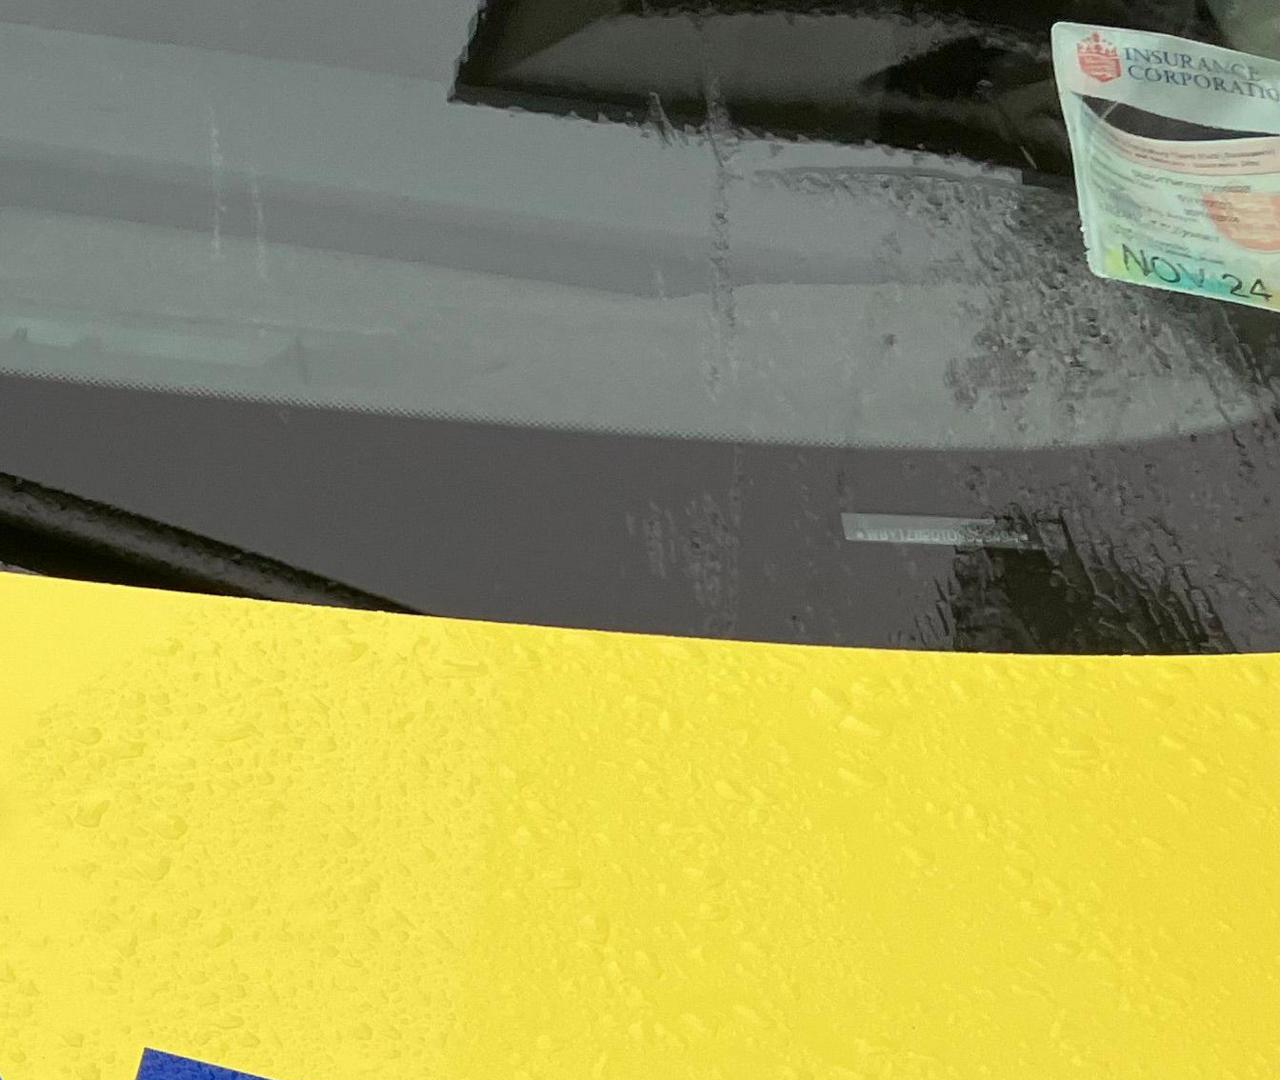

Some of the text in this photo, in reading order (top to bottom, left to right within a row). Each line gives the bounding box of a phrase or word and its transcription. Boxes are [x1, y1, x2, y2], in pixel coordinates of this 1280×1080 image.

[1124, 47, 1262, 82] INSURANCE
[1127, 64, 1280, 102] CORPORATIO
[1122, 243, 1205, 288] NOV
[1222, 273, 1273, 301] 24
